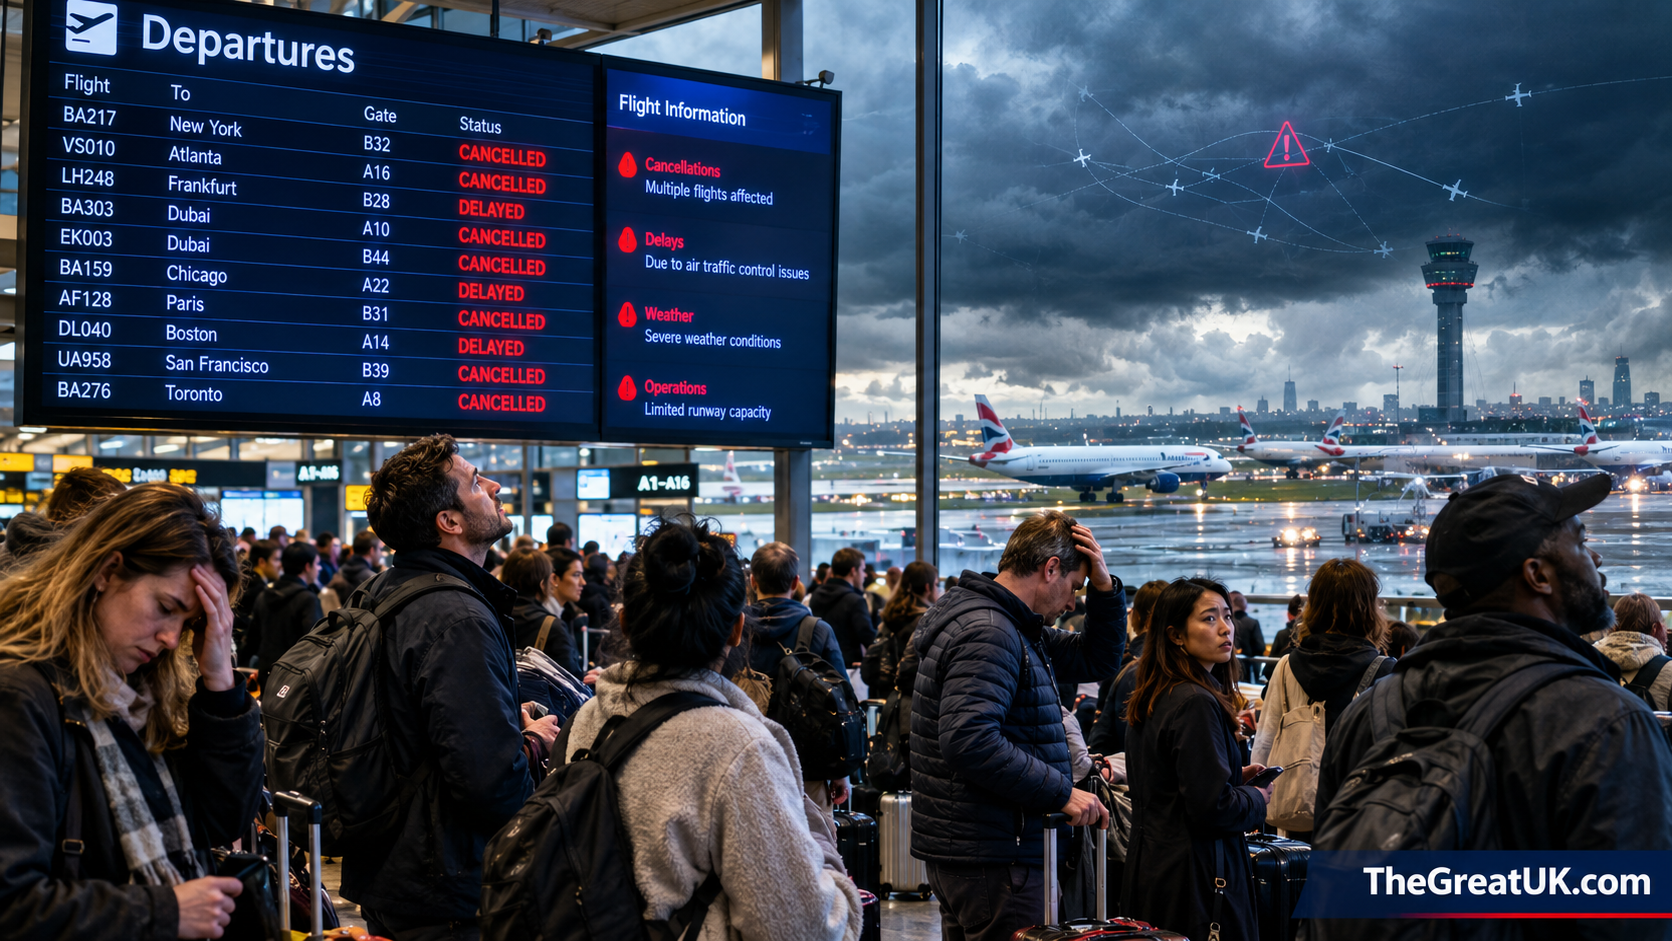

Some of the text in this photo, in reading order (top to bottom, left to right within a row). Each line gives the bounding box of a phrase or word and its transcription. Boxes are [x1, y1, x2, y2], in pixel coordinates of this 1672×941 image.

[142, 13, 355, 74] Departures
[65, 74, 110, 95] Flight
[171, 85, 190, 101] To
[64, 106, 116, 125] BA217
[364, 106, 397, 123] Gate
[620, 94, 745, 126] Flight Information
[171, 116, 241, 137] New York
[460, 116, 501, 134] Status
[63, 137, 114, 156] VS010
[365, 136, 390, 152] B32
[169, 146, 221, 164] Atlanta
[459, 144, 546, 167] CANCELLED
[363, 164, 390, 180] A16
[646, 157, 720, 177] Cancellations
[63, 167, 113, 186] LH248
[169, 175, 236, 195] Frankfurt
[459, 172, 546, 194] CANCELLED
[364, 192, 389, 208] B28
[646, 180, 772, 205] Multiple flights affected
[62, 198, 113, 216] BA303
[169, 205, 210, 223] Dubai
[459, 199, 524, 219] DELAYED
[61, 229, 112, 246] EK003
[363, 221, 389, 236] A10
[459, 227, 546, 248] CANCELLED
[168, 235, 209, 252] Dubai
[646, 232, 684, 251] Delays
[364, 249, 389, 264] B44
[459, 255, 546, 276] CANCELLED
[61, 259, 112, 277] BA159
[167, 265, 227, 286] Chicago
[646, 255, 809, 279] Due to air traffic control issues
[363, 278, 389, 293] A22
[459, 282, 524, 301] DELAYED
[59, 290, 111, 307] AF128
[167, 295, 204, 311] Paris
[363, 306, 389, 322] B31
[458, 310, 545, 330] CANCELLED
[645, 306, 694, 322] Weather
[59, 320, 111, 337] DL040
[167, 325, 216, 341] Boston
[363, 334, 389, 349] A14
[459, 338, 524, 356] DELAYED
[646, 329, 781, 348] Severe weather conditions
[59, 351, 111, 368] UA958
[166, 355, 268, 373] San Francisco
[363, 363, 389, 378] B39
[458, 365, 545, 384] CANCELLED
[58, 382, 110, 398] BA276
[165, 385, 222, 401] Toronto
[645, 379, 706, 396] Operations
[362, 391, 380, 406] A8
[458, 394, 546, 412] CANCELLED
[646, 402, 771, 421] Limited runway capacity
[638, 476, 690, 491] A1-A16
